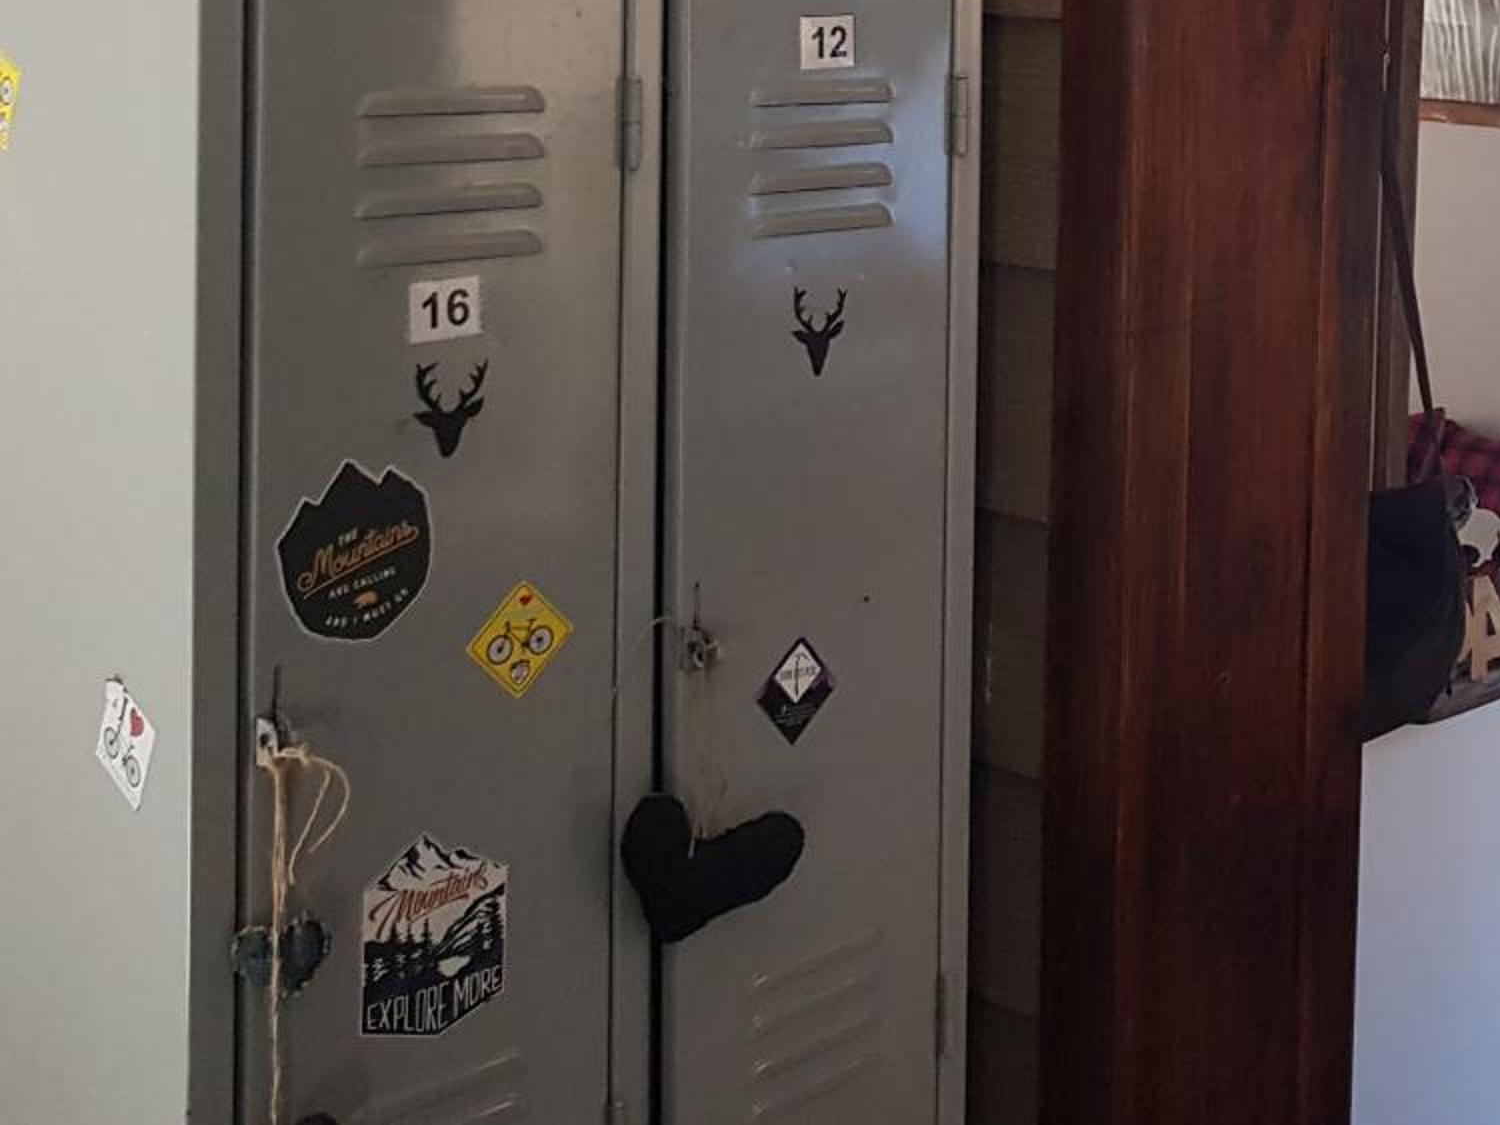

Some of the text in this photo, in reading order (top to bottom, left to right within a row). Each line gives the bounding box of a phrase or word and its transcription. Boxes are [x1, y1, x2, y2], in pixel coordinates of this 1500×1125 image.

[811, 25, 848, 59] 12
[422, 289, 470, 329] 16
[297, 520, 420, 593] Mountains
[369, 859, 489, 940] Mountains
[366, 964, 502, 1032] EXPLORE MORE
